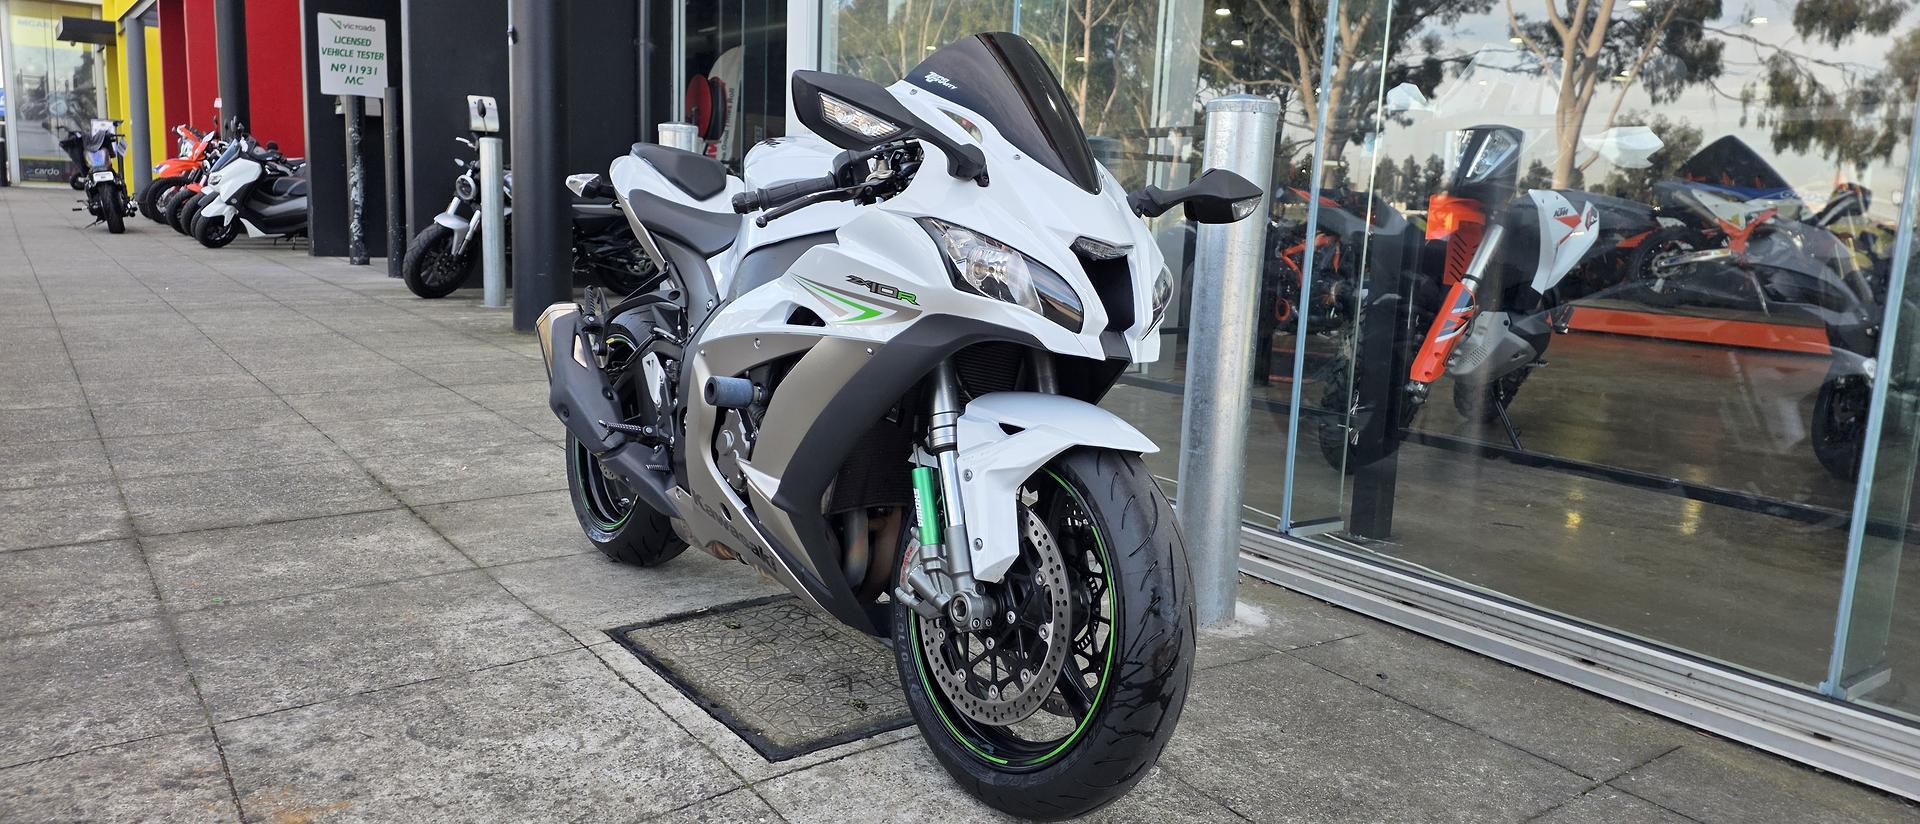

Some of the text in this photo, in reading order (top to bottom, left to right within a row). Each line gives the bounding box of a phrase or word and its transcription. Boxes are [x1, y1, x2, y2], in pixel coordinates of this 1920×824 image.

[334, 35, 372, 47] LICENSED
[321, 47, 385, 61] VEHICLE TESTER
[349, 64, 378, 75] 11931
[344, 76, 365, 86] MC
[34, 168, 60, 176] cardo
[1553, 207, 1569, 217] KTM
[691, 487, 778, 574] Kawasaki
